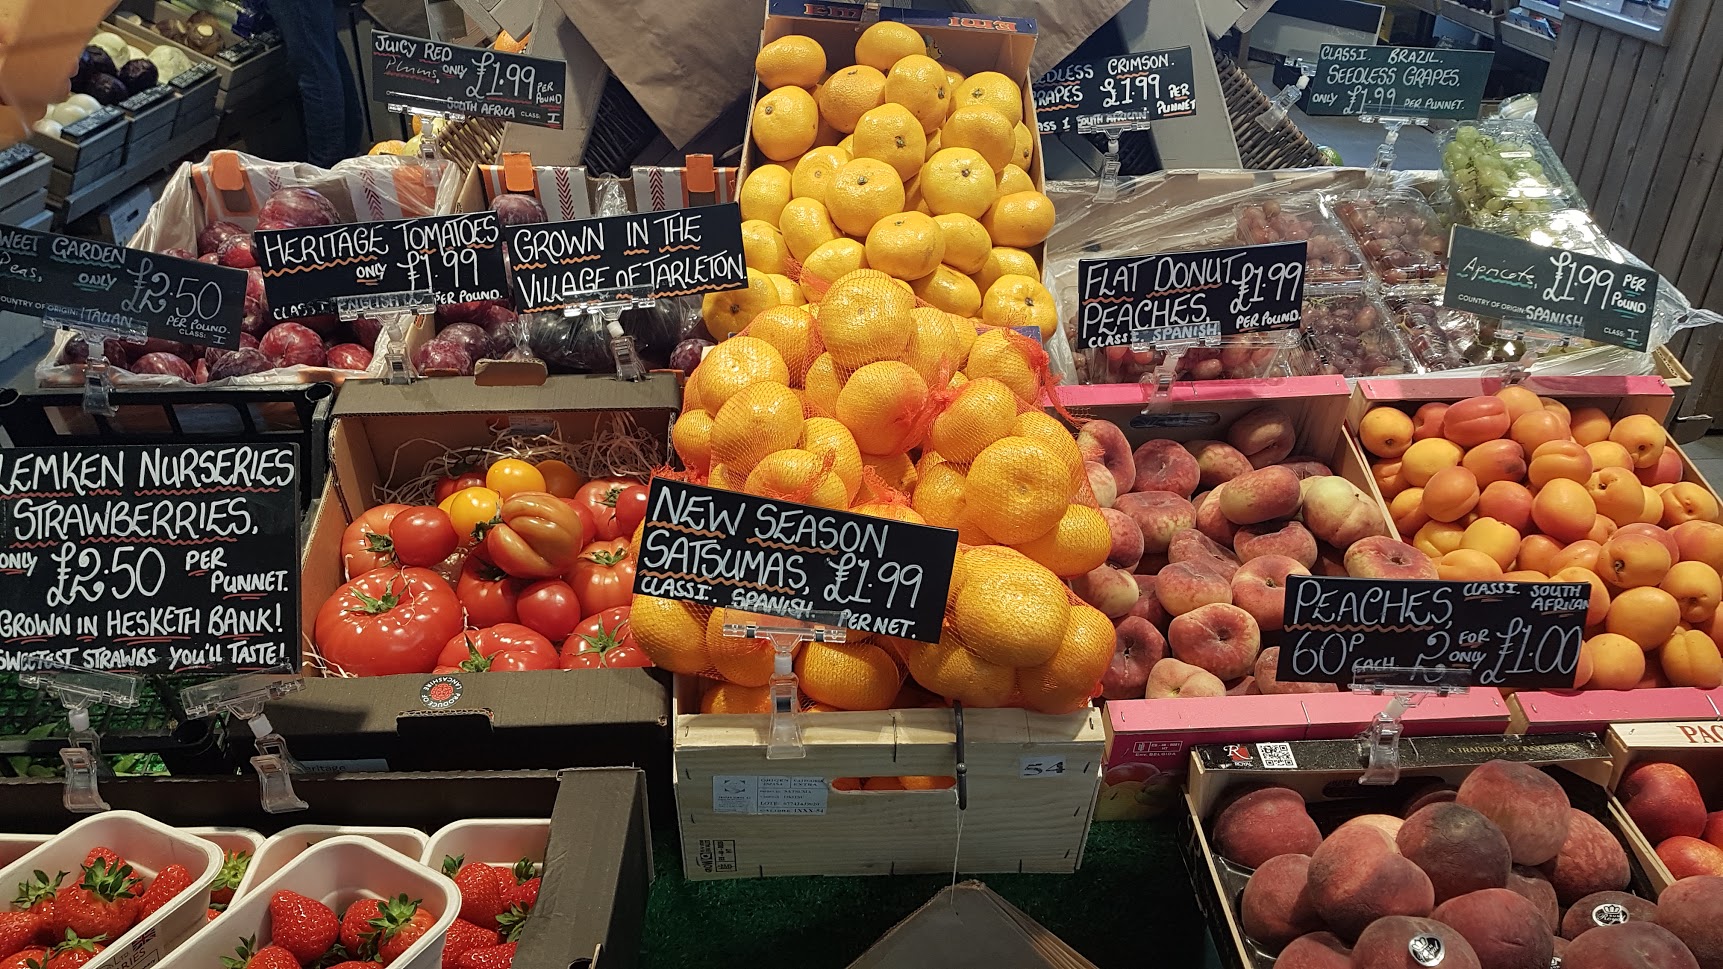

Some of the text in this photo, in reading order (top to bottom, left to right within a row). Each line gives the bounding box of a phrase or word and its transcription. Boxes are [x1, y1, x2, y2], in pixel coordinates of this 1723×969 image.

[375, 34, 452, 62] JUICY RED
[1388, 49, 1444, 63] BRAZIL.
[442, 64, 468, 79] ONLY
[465, 52, 536, 100] £1.99
[1107, 54, 1175, 75] CRIMSON.
[1327, 65, 1397, 85] SEEDLESS
[535, 92, 562, 105] POUND
[537, 82, 554, 92] PER
[1100, 74, 1161, 108] £1.99
[1168, 83, 1190, 98] PER
[446, 96, 515, 118] SOUTH AFRICA
[1157, 99, 1196, 114] PUNNET
[1313, 85, 1464, 114] ONLY £1.99 PER PUNNET.
[547, 112, 560, 124] I
[1076, 113, 1103, 126] SOUTH
[263, 214, 498, 267] HERITAGE TOMATOES
[514, 212, 701, 264] GROWN IN THE
[52, 236, 127, 264] GARDEN
[79, 272, 118, 290] ONLY
[357, 249, 479, 300] ONLY £1.99
[517, 250, 747, 308] VILLAGE OF TARLETON.
[1084, 252, 1303, 314] FLAT DONUT £1.99
[1542, 251, 1615, 309] £1.99
[1623, 273, 1647, 292] PER
[121, 257, 222, 320] £2.50
[459, 288, 503, 301] POUND.
[35, 301, 46, 310] OF
[47, 304, 78, 316] ORIGIN:
[80, 307, 133, 327] ITALIAN
[1458, 293, 1490, 307] COUNTRY
[1491, 301, 1500, 309] OF
[1526, 305, 1584, 327] SPANISH
[1612, 291, 1647, 314] POUND
[166, 315, 231, 334] PER POUND.
[1236, 310, 1302, 329] PER POUND.
[178, 328, 226, 345] CLASS: I
[1627, 329, 1639, 341] I
[139, 446, 295, 488] NURSERIES
[652, 486, 888, 558] NEW SEASON
[0, 542, 227, 606] ONLY £2.50 PER
[643, 529, 923, 608] SATSUMAS, £1.99
[210, 570, 289, 592] PUNNET.
[1294, 580, 1453, 629] PEACHES,
[1530, 584, 1581, 598] SOUTH
[1531, 598, 1589, 611] AFRICAN
[0, 603, 283, 638] GROWN IN HESKETH BANK!
[838, 612, 871, 632] PER
[872, 618, 916, 639] NET.
[0, 647, 78, 671] SWEETEST
[83, 647, 157, 671] STRAWBS
[227, 640, 285, 665] TASTE!
[1411, 631, 1450, 682] 2
[1459, 631, 1490, 644] FOR
[1481, 617, 1582, 684] £1.00
[1450, 652, 1487, 669] ONLY
[423, 677, 462, 691] LANCASHIRE
[1024, 762, 1065, 776] 54
